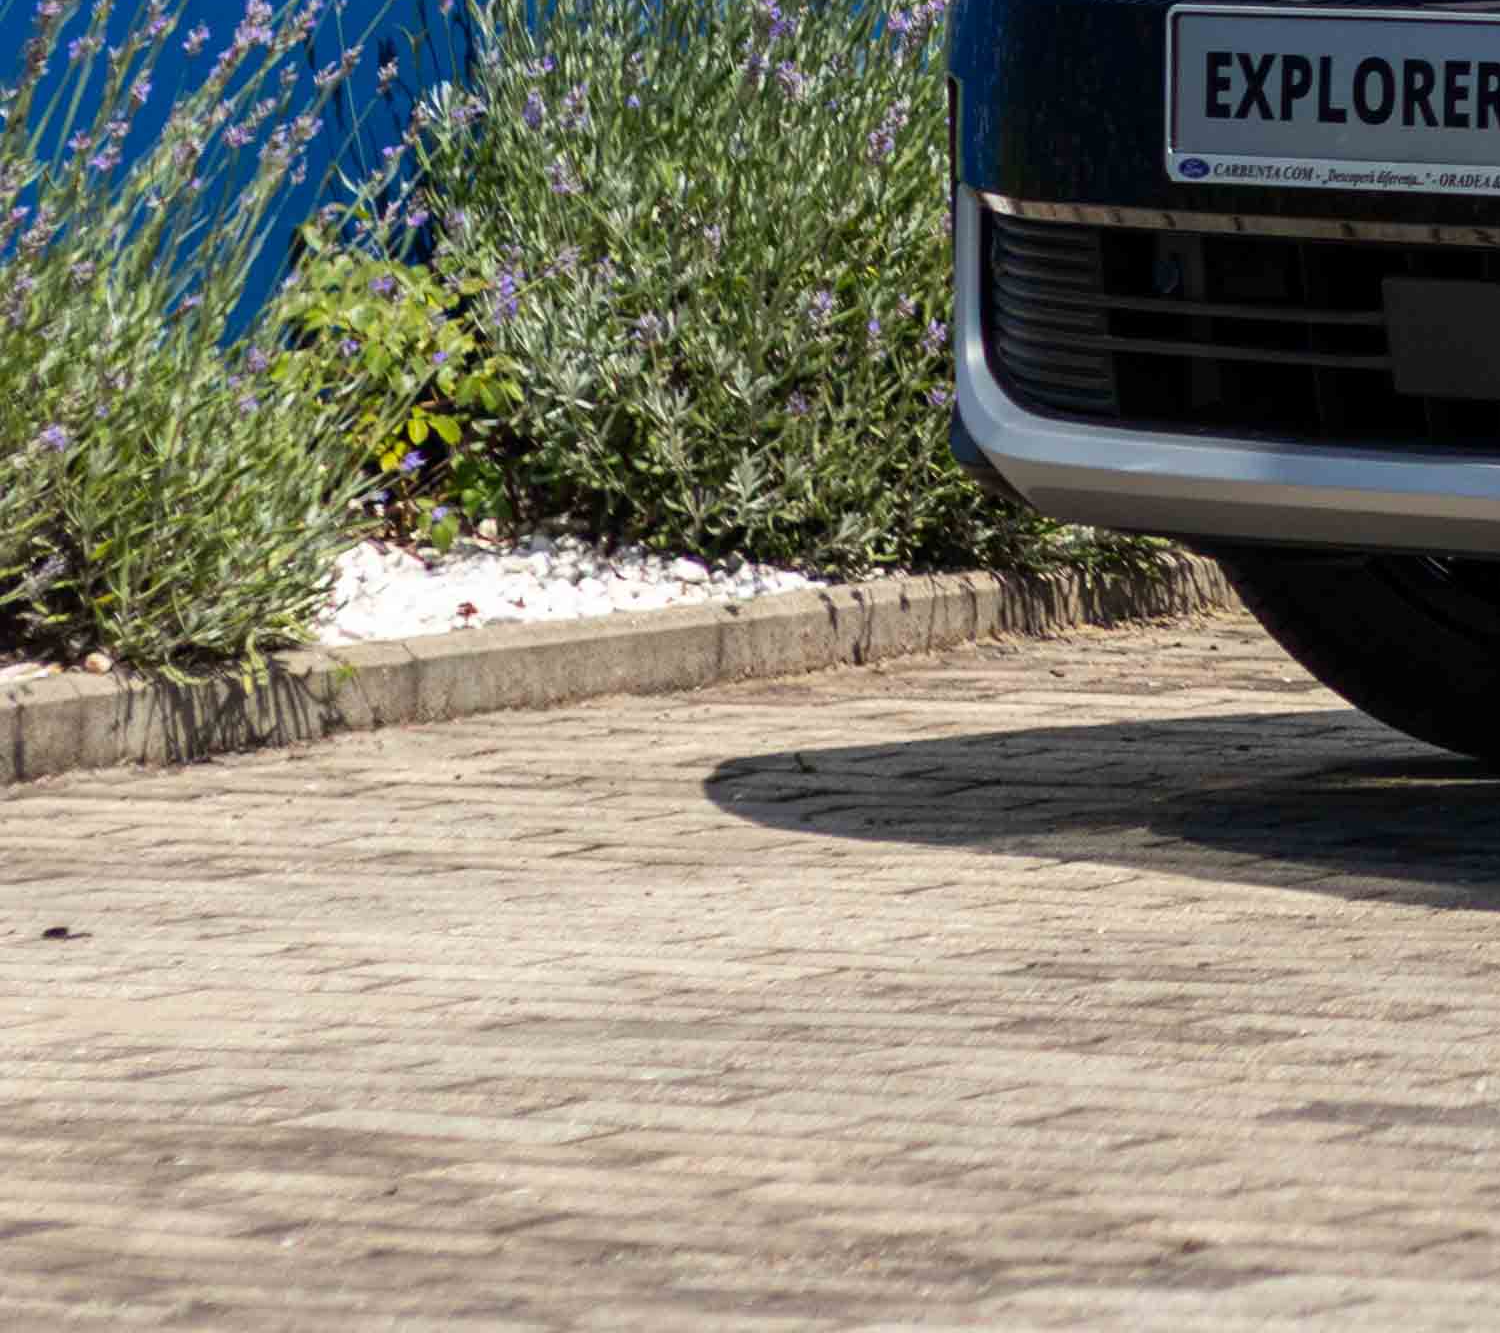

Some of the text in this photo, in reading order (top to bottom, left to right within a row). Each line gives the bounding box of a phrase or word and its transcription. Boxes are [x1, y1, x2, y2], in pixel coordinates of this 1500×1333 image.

[1213, 162, 1281, 181] CARBENTA
[1283, 164, 1314, 182] COM
[1439, 173, 1491, 190] ORADEA
